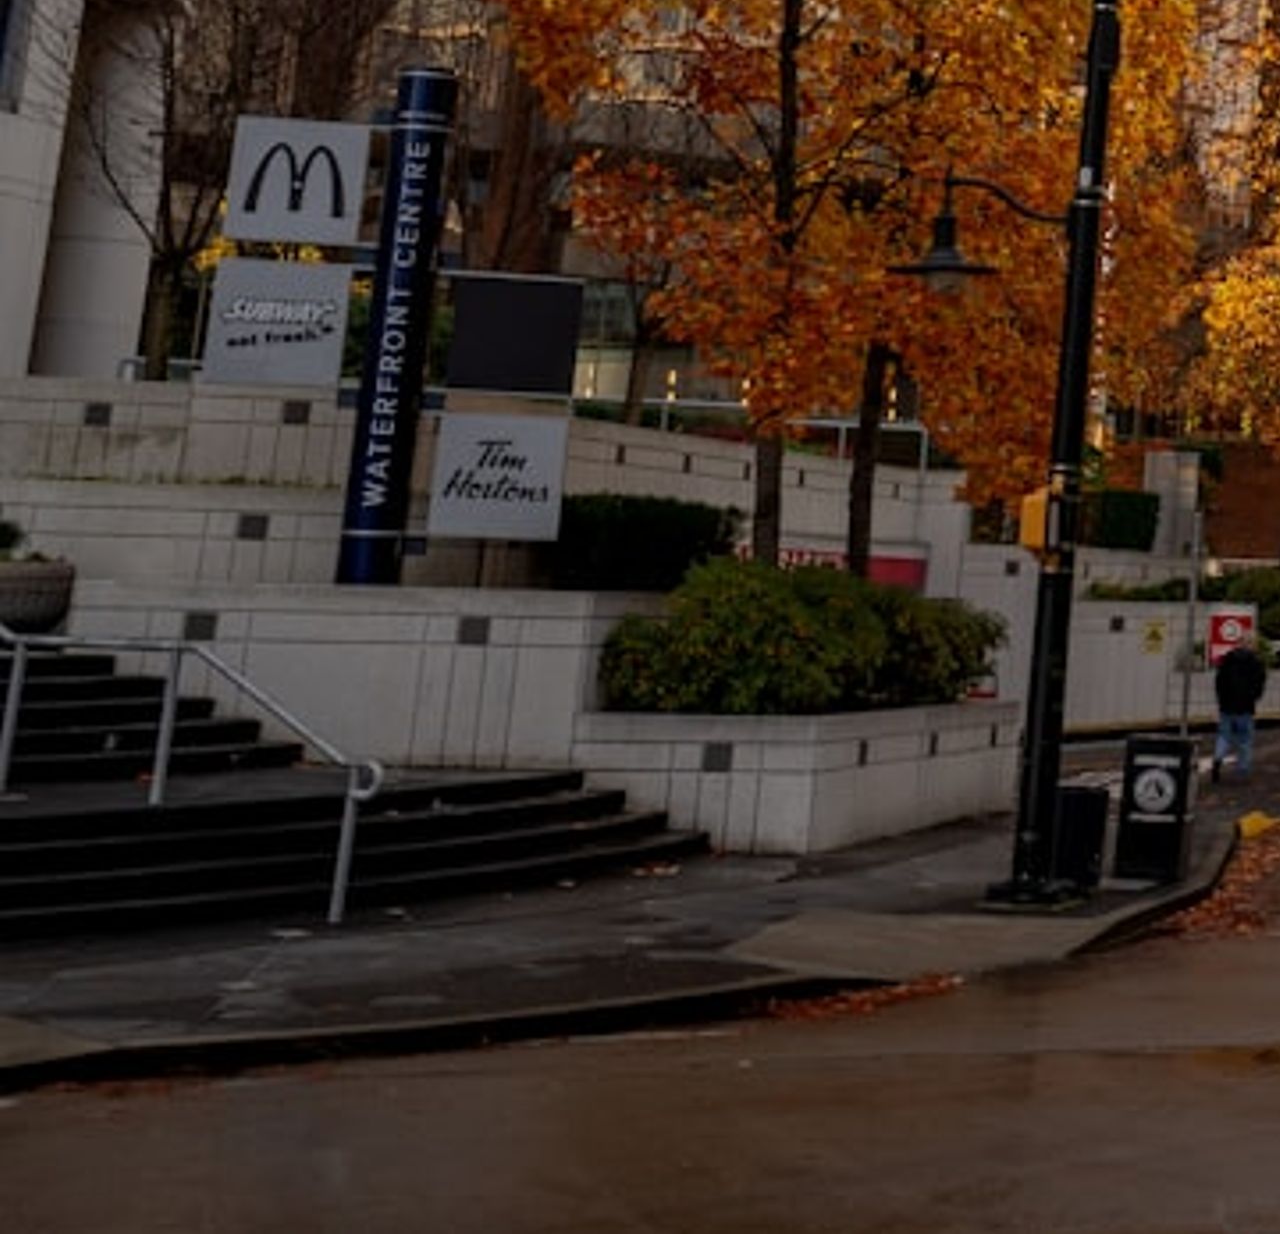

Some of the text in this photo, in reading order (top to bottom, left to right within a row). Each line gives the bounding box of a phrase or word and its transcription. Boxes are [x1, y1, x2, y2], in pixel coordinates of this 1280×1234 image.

[362, 142, 430, 507] WATERFRONT CENTRE
[477, 440, 527, 472] Tim
[443, 468, 549, 503] Hortons
